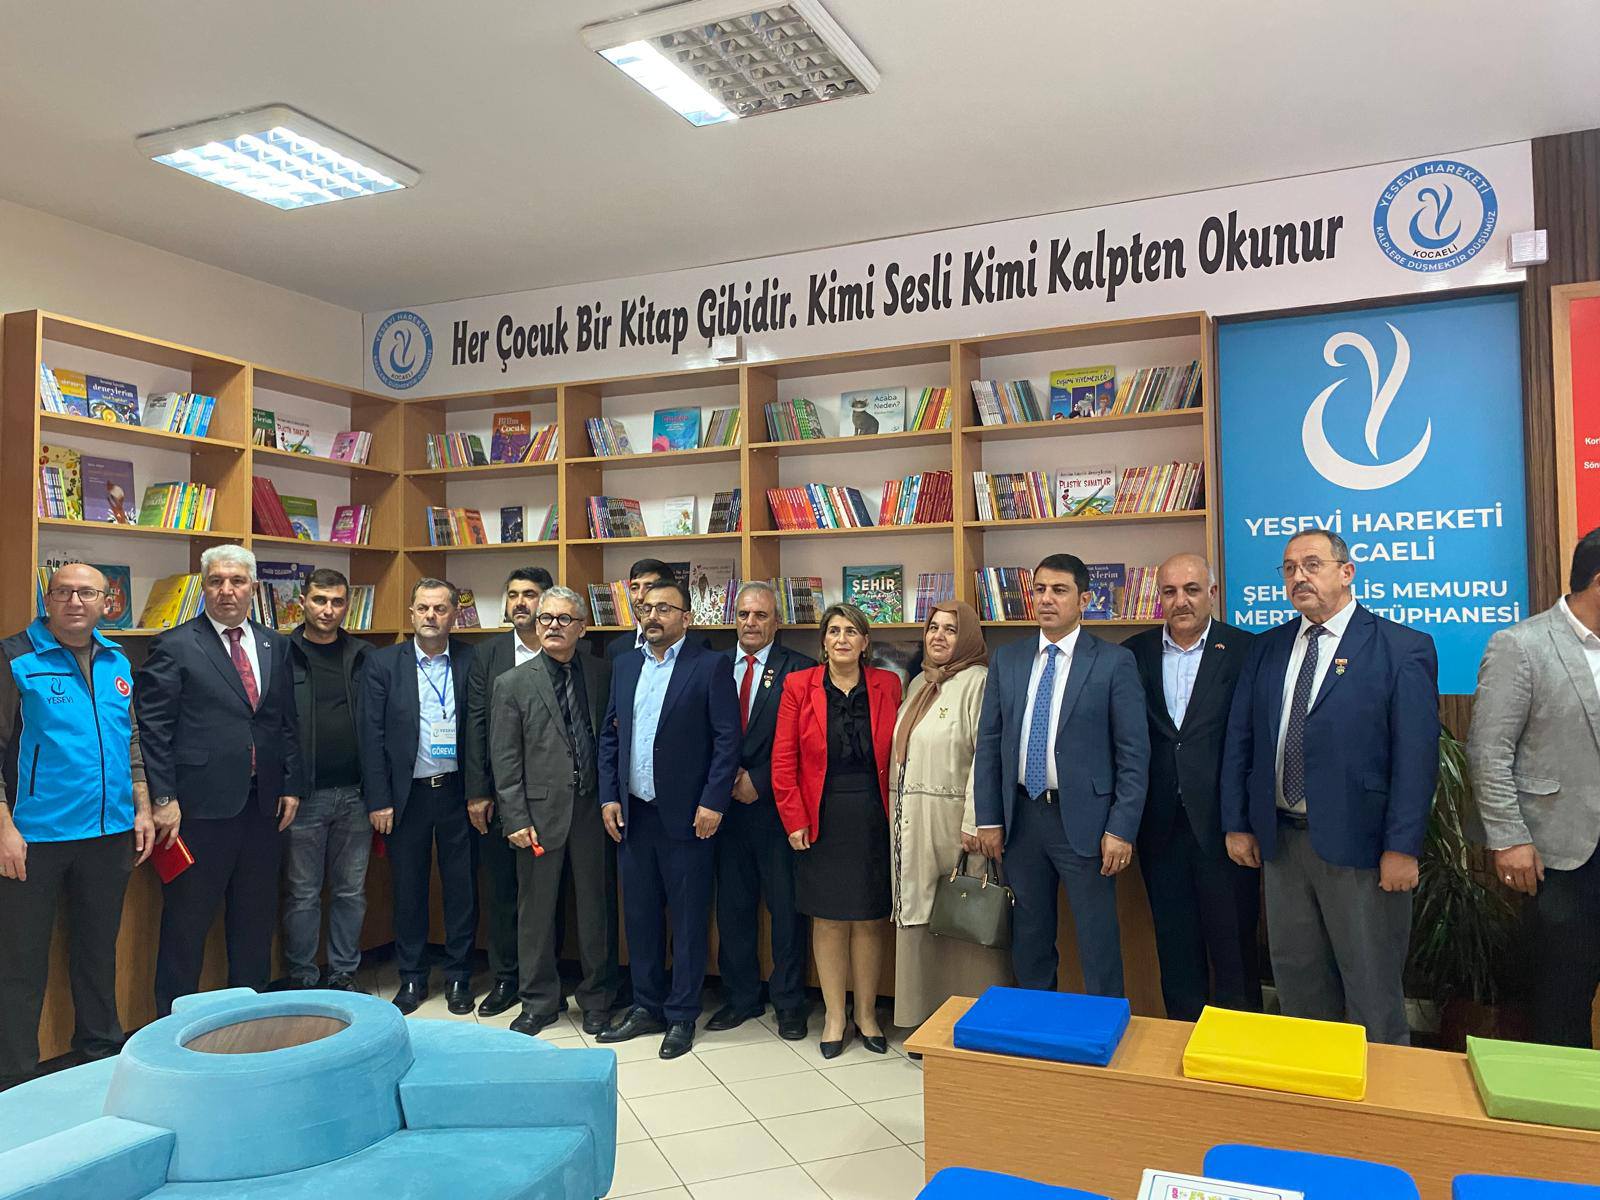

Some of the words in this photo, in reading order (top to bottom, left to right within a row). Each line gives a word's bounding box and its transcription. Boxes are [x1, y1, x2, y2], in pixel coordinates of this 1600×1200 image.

[1379, 167, 1419, 208] YESEVİ
[1424, 163, 1493, 195] HAREKETİ
[1376, 226, 1407, 265] KALPLERE
[1412, 243, 1459, 259] KOCAELİ
[451, 320, 489, 366] Her
[496, 305, 569, 373] Çocuk
[576, 301, 612, 353] Bir
[619, 294, 689, 355] Kitap
[697, 277, 797, 348] Gibidir.
[806, 264, 875, 326] Kimi
[883, 252, 952, 317] Sesli
[961, 239, 1037, 306] Kimi
[1047, 228, 1187, 303] Kalpten
[1198, 209, 1344, 274] Okunur
[873, 401, 901, 410] Neden?
[874, 393, 898, 402] Acaba
[1584, 437, 1600, 445] Kor
[1583, 461, 1600, 469] Sön
[1244, 509, 1342, 537] YESEVİ
[1352, 501, 1503, 533] HAREKETİ
[1349, 535, 1436, 562] CAELİ
[851, 577, 895, 592] ŞEHİR
[1243, 585, 1287, 606] ŞEH
[1351, 579, 1386, 600] LİS
[1392, 580, 1508, 599] MEMURU
